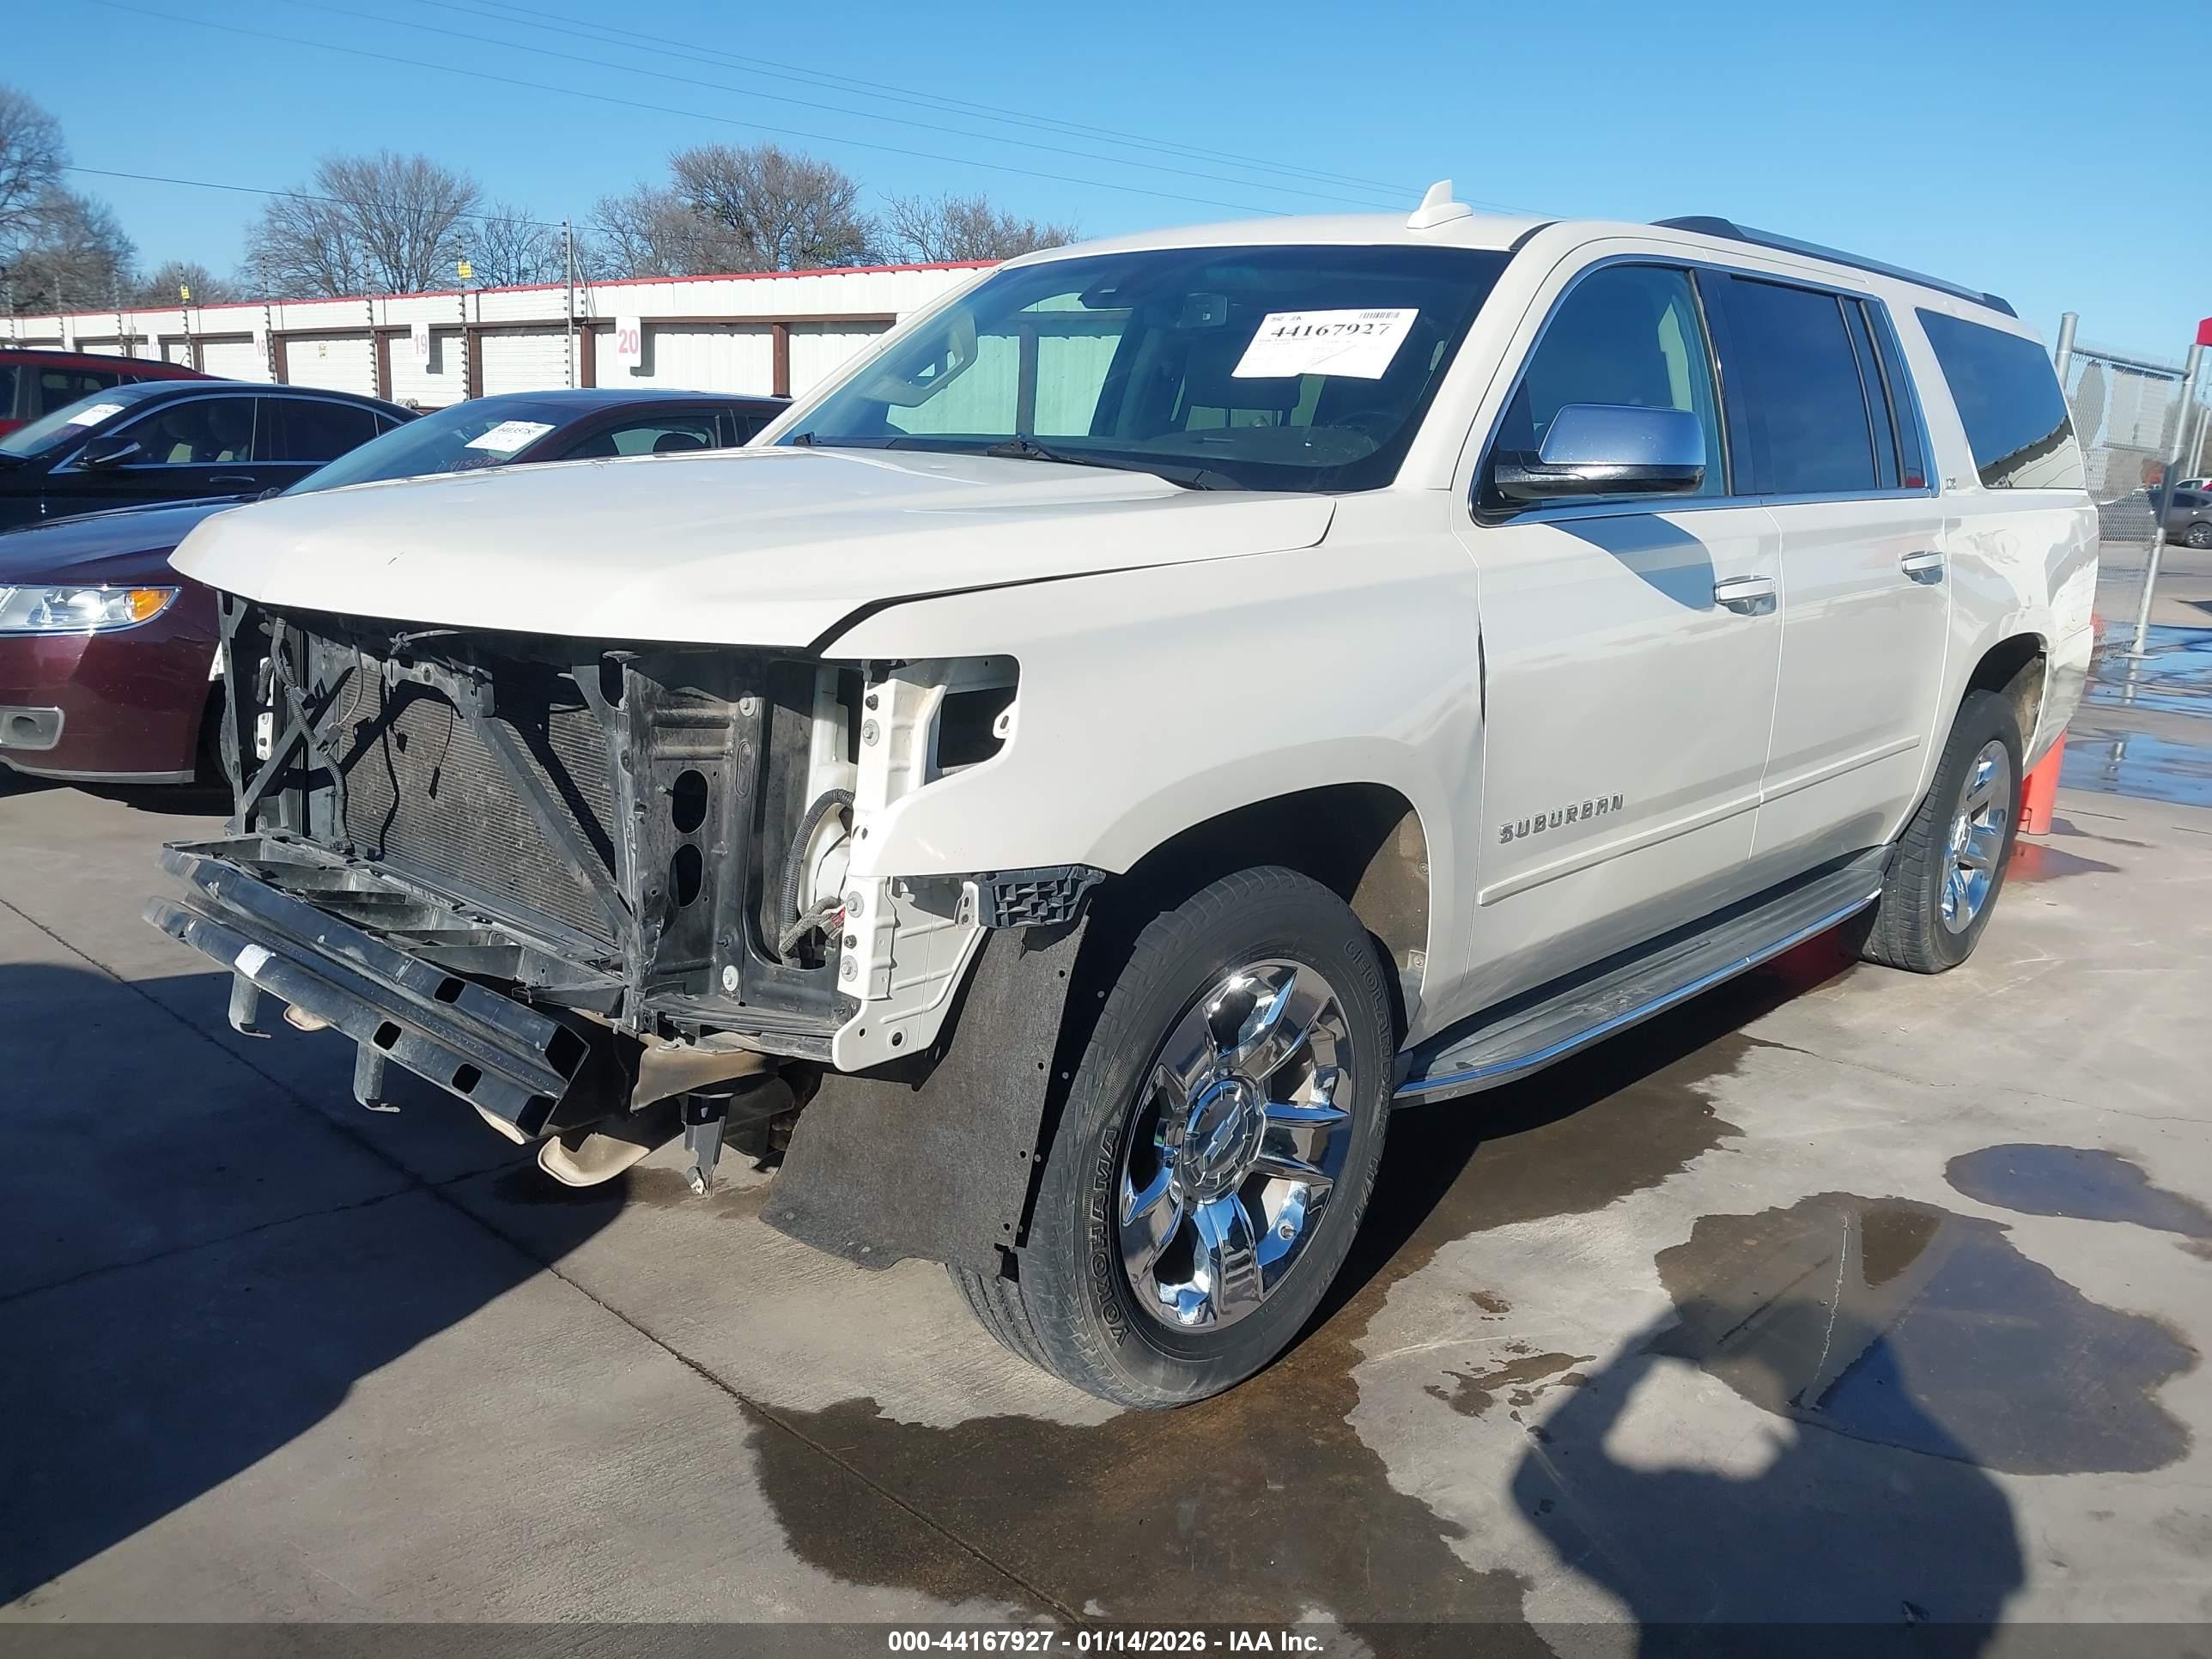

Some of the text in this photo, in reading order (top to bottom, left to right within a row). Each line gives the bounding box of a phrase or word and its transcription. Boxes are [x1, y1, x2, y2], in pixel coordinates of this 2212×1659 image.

[1271, 323, 1393, 337] 44167927
[256, 339, 266, 356] 18
[413, 334, 428, 354] 19
[618, 329, 639, 354] 20
[1499, 791, 1625, 844] SUBURBAN
[1090, 1127, 1130, 1347] YOKOHAMA
